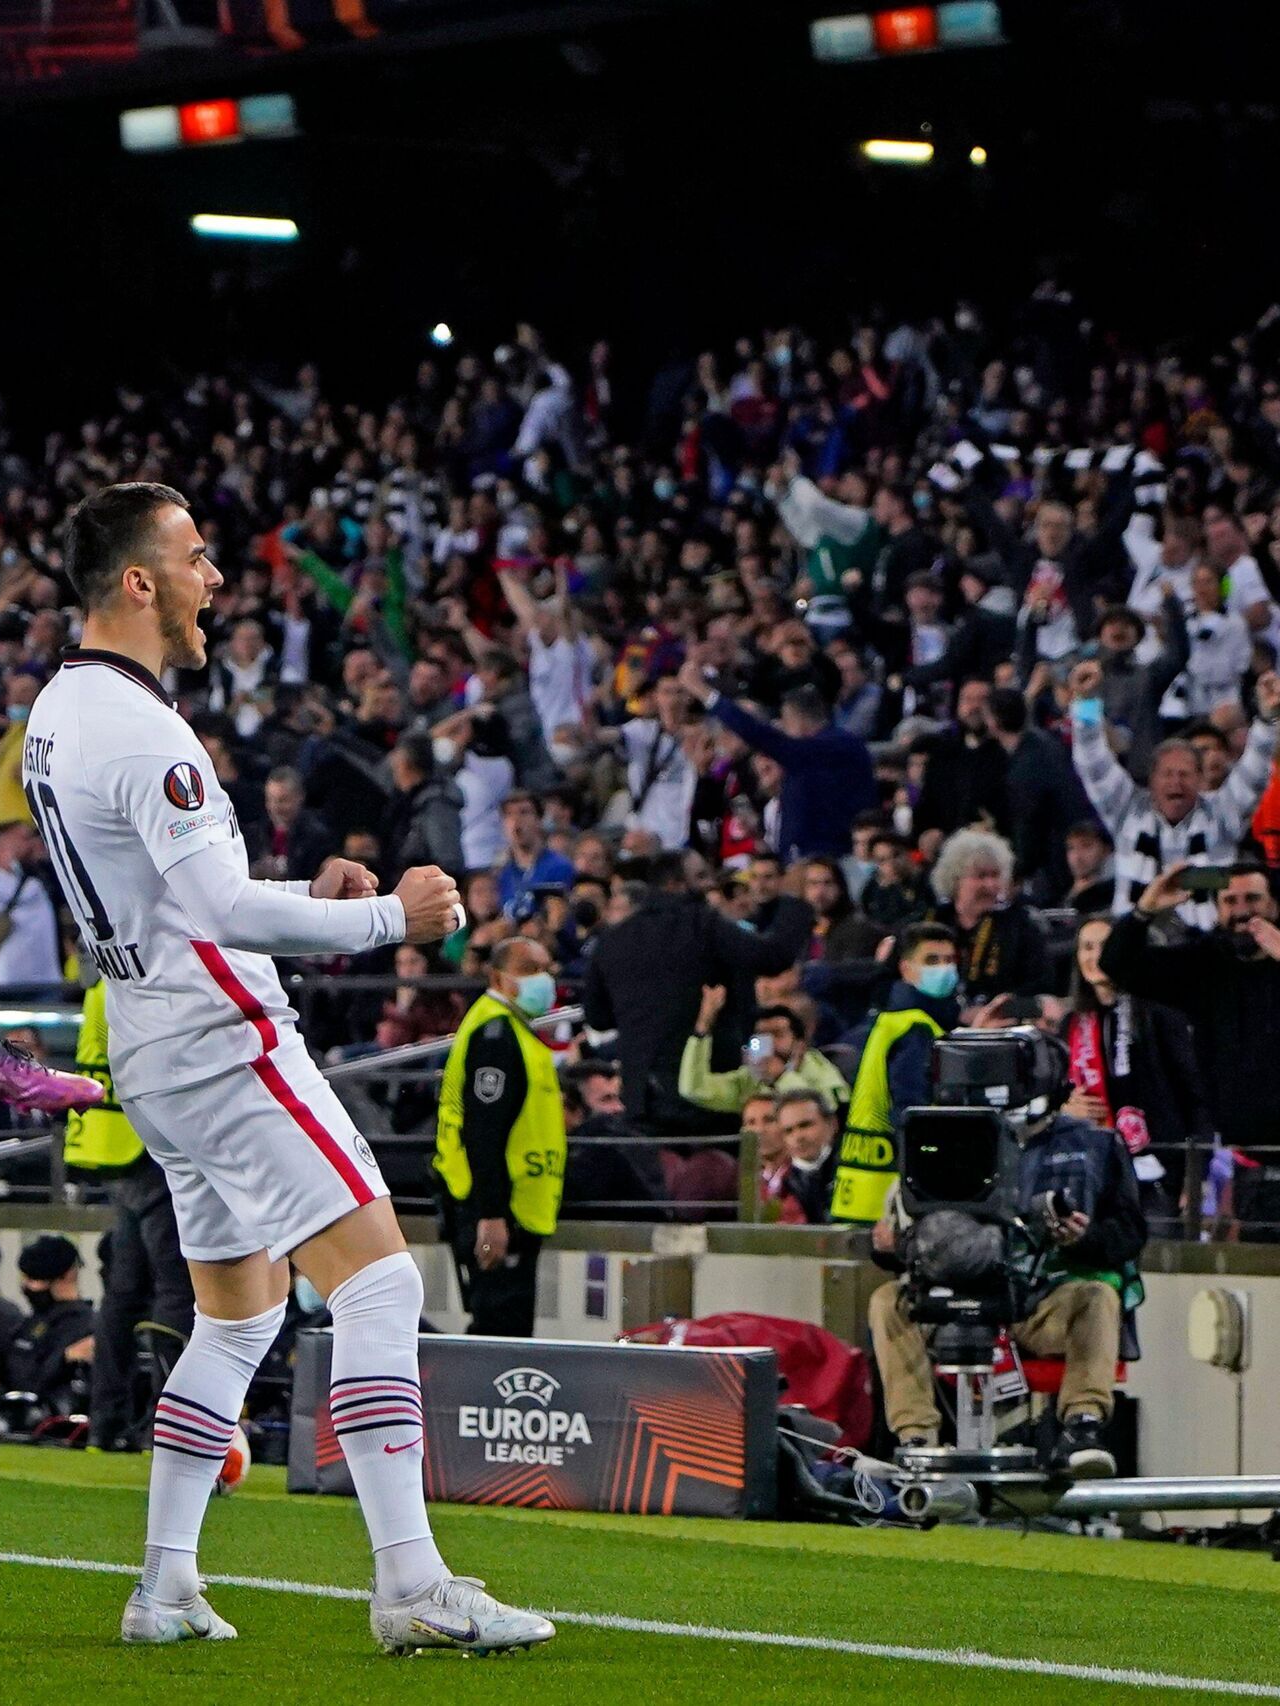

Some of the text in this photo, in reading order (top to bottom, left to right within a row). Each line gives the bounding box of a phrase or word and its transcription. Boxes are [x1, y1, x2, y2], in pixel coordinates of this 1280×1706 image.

[496, 1374, 555, 1402] UEFA
[458, 1405, 593, 1445] EUROPA
[484, 1441, 564, 1466] LEAGUE
